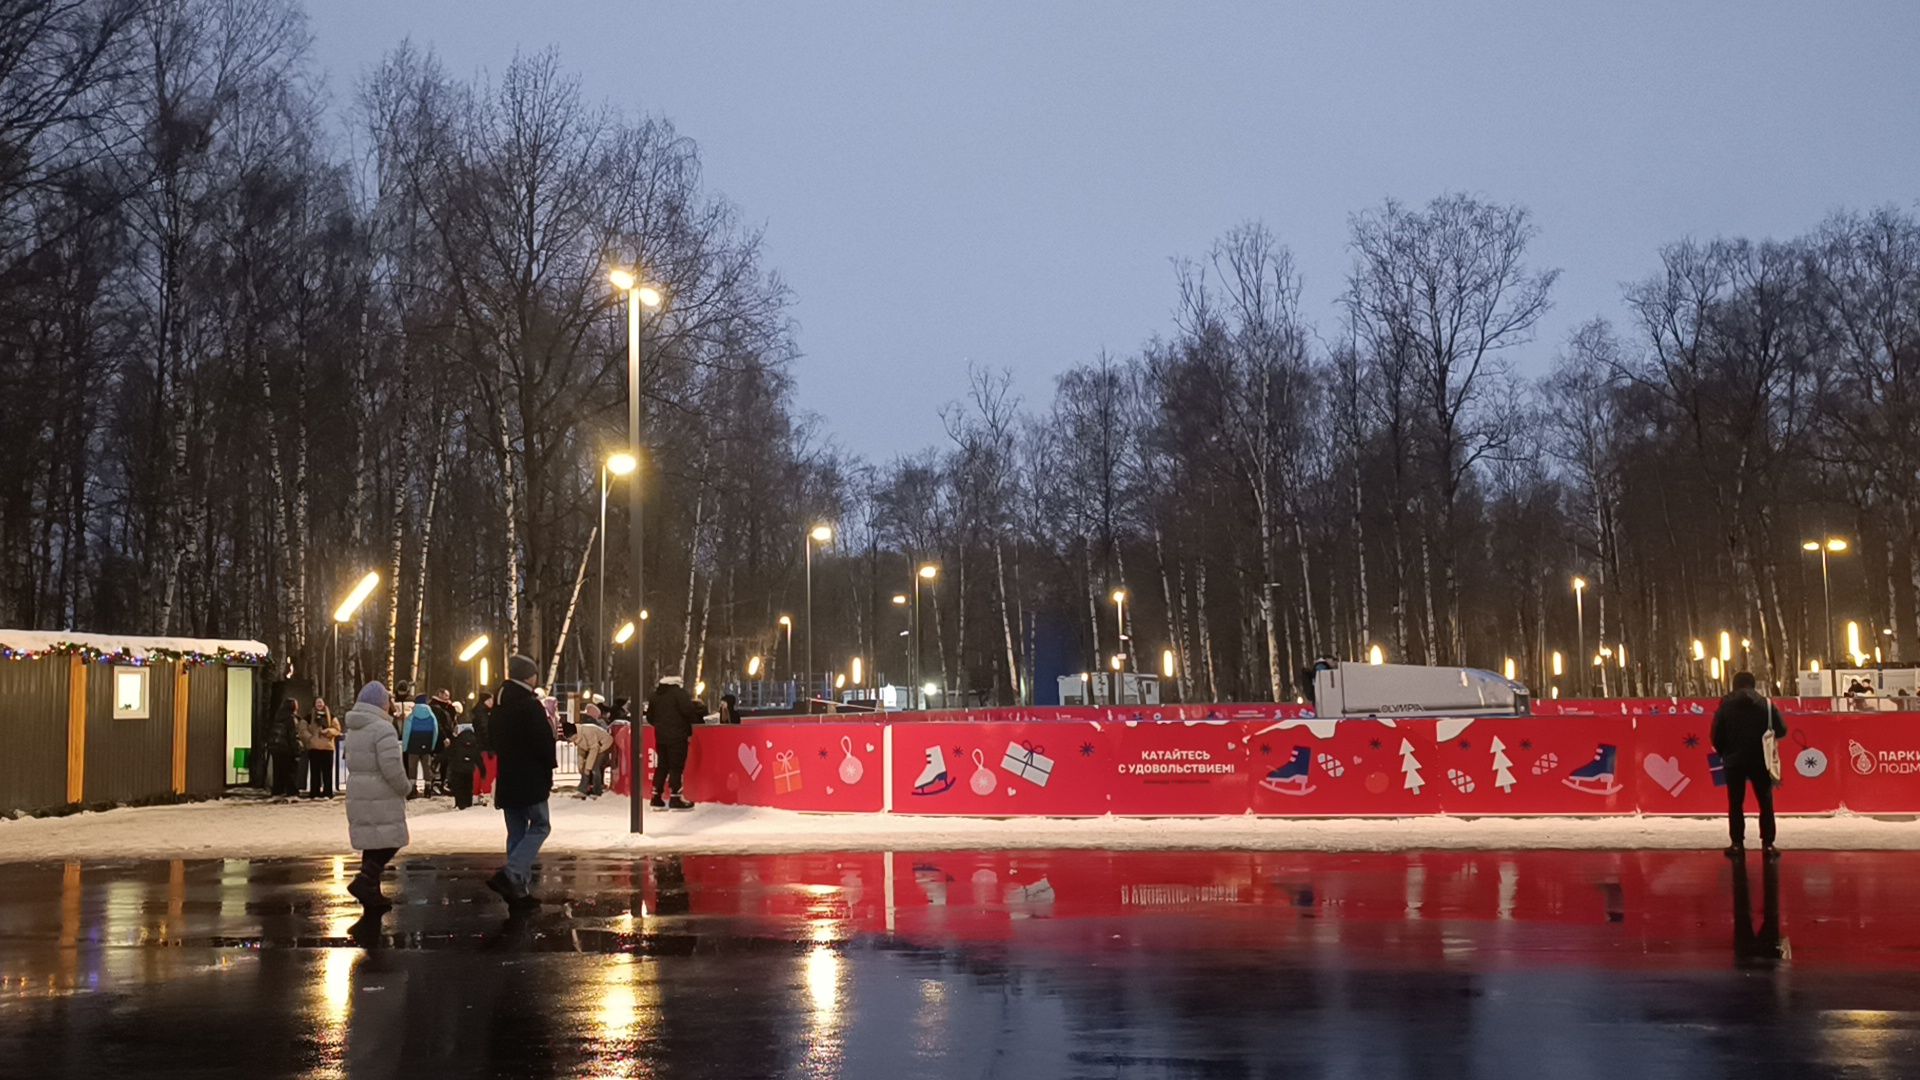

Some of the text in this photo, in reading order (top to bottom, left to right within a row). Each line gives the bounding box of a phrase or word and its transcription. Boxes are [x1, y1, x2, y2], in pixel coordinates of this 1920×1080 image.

[1381, 703, 1423, 713] OLYMPIA
[1141, 748, 1211, 760] КАТАЙТЕСЬ
[1118, 764, 1235, 775] С УДОВОЛЬСТВИЕМ!
